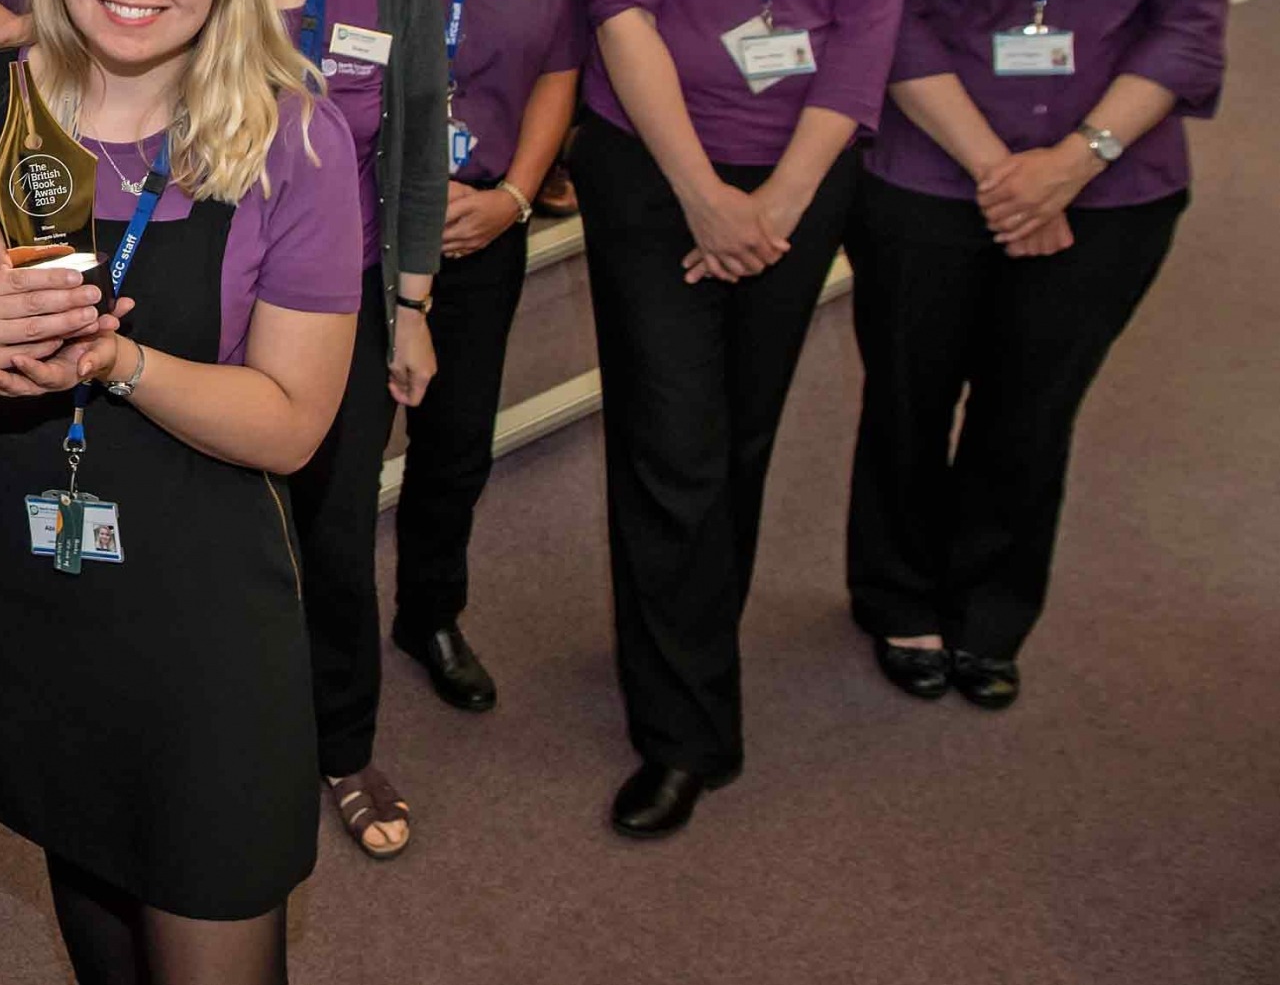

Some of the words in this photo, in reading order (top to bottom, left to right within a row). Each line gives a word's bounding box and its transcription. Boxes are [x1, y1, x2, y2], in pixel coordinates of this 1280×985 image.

[29, 163, 47, 172] The
[30, 169, 61, 181] British
[32, 179, 55, 190] Book
[34, 186, 67, 198] Awards
[35, 196, 56, 206] 2019
[121, 233, 138, 260] staff
